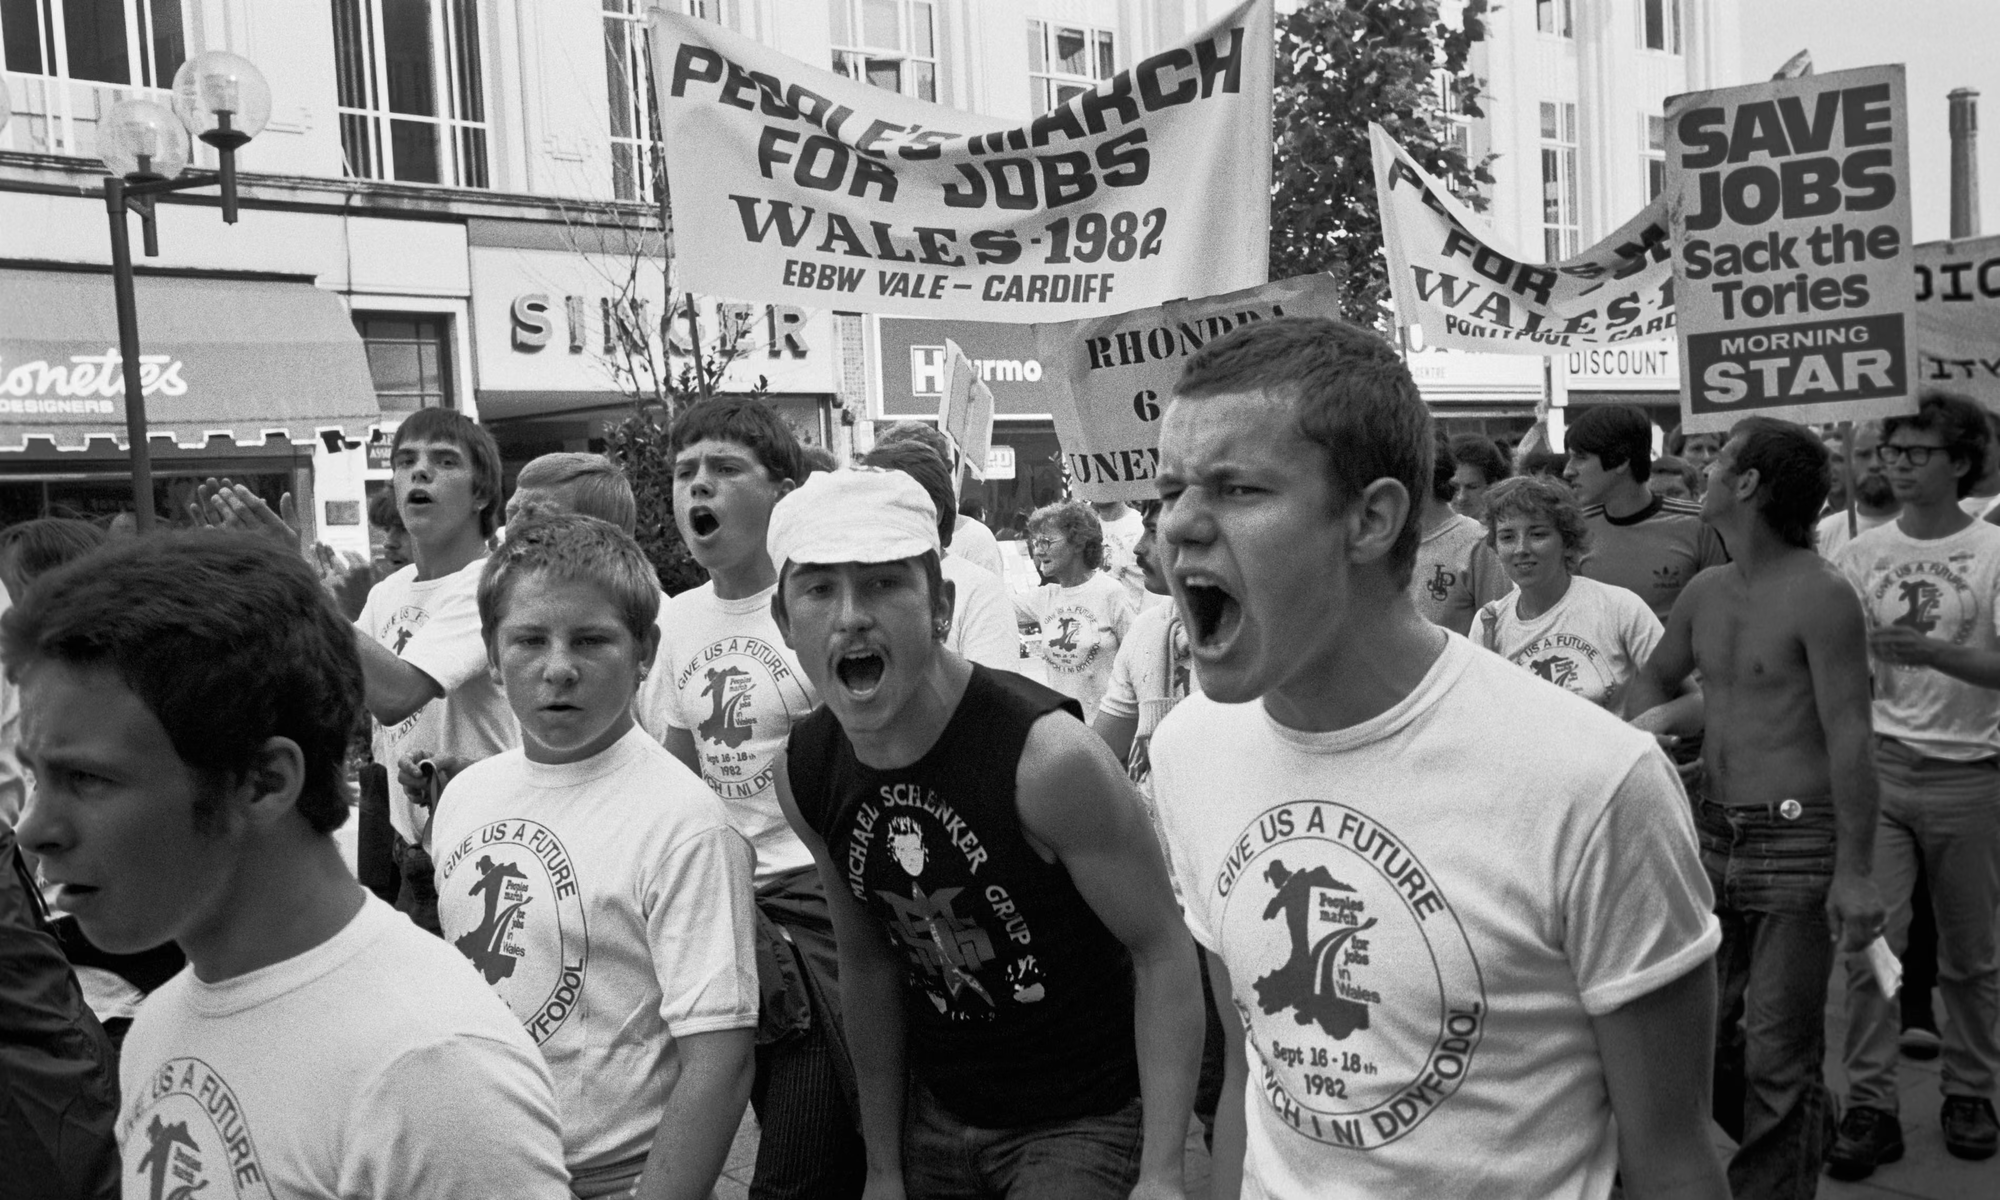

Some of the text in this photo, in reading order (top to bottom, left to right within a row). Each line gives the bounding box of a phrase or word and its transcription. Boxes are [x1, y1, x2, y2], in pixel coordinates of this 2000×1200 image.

[1678, 82, 1893, 169] SAVE
[758, 125, 1150, 210] FOR JOBS
[1685, 149, 1897, 231] JOBS
[1441, 228, 1558, 306] FOR
[1682, 231, 1800, 280] Sack
[1806, 223, 1900, 267] the
[782, 260, 866, 292] EBBW
[878, 270, 948, 300] VALE
[981, 273, 1114, 303] CARDIFF
[1711, 273, 1870, 320] Tories
[511, 293, 810, 360] SINGER
[1085, 305, 1284, 369] RHOND
[1607, 311, 1677, 342] CARD
[1721, 326, 1869, 355] MORNING
[0, 348, 188, 396] onetes
[1570, 351, 1669, 375] DISCOUNT
[1703, 349, 1895, 404] STAR
[677, 638, 790, 691] GIVE US A FUTURE
[1543, 638, 1552, 648] A
[1556, 635, 1598, 661] FUTURE
[720, 766, 742, 776] 1982
[443, 823, 576, 901] GIVE US A FUTURE
[848, 802, 880, 901] MICHAEL
[880, 783, 988, 875] SCHENKER
[1217, 805, 1444, 921] GIVE US A FUTURE
[1319, 892, 1364, 914] Peoples
[1319, 910, 1358, 926] march
[1343, 947, 1369, 966] jobs
[1351, 934, 1369, 951] for
[1335, 980, 1381, 1004] Wales
[1337, 963, 1351, 982] in
[526, 957, 584, 1043] YFODOL
[1272, 1040, 1304, 1068] Sept
[1312, 1114, 1323, 1138] I
[1331, 1118, 1365, 1147] NI
[1371, 1001, 1480, 1141] DDYFODOL
[1303, 1073, 1348, 1100] 1982
[180, 1063, 195, 1090] A
[200, 1073, 261, 1190] FUTURE
